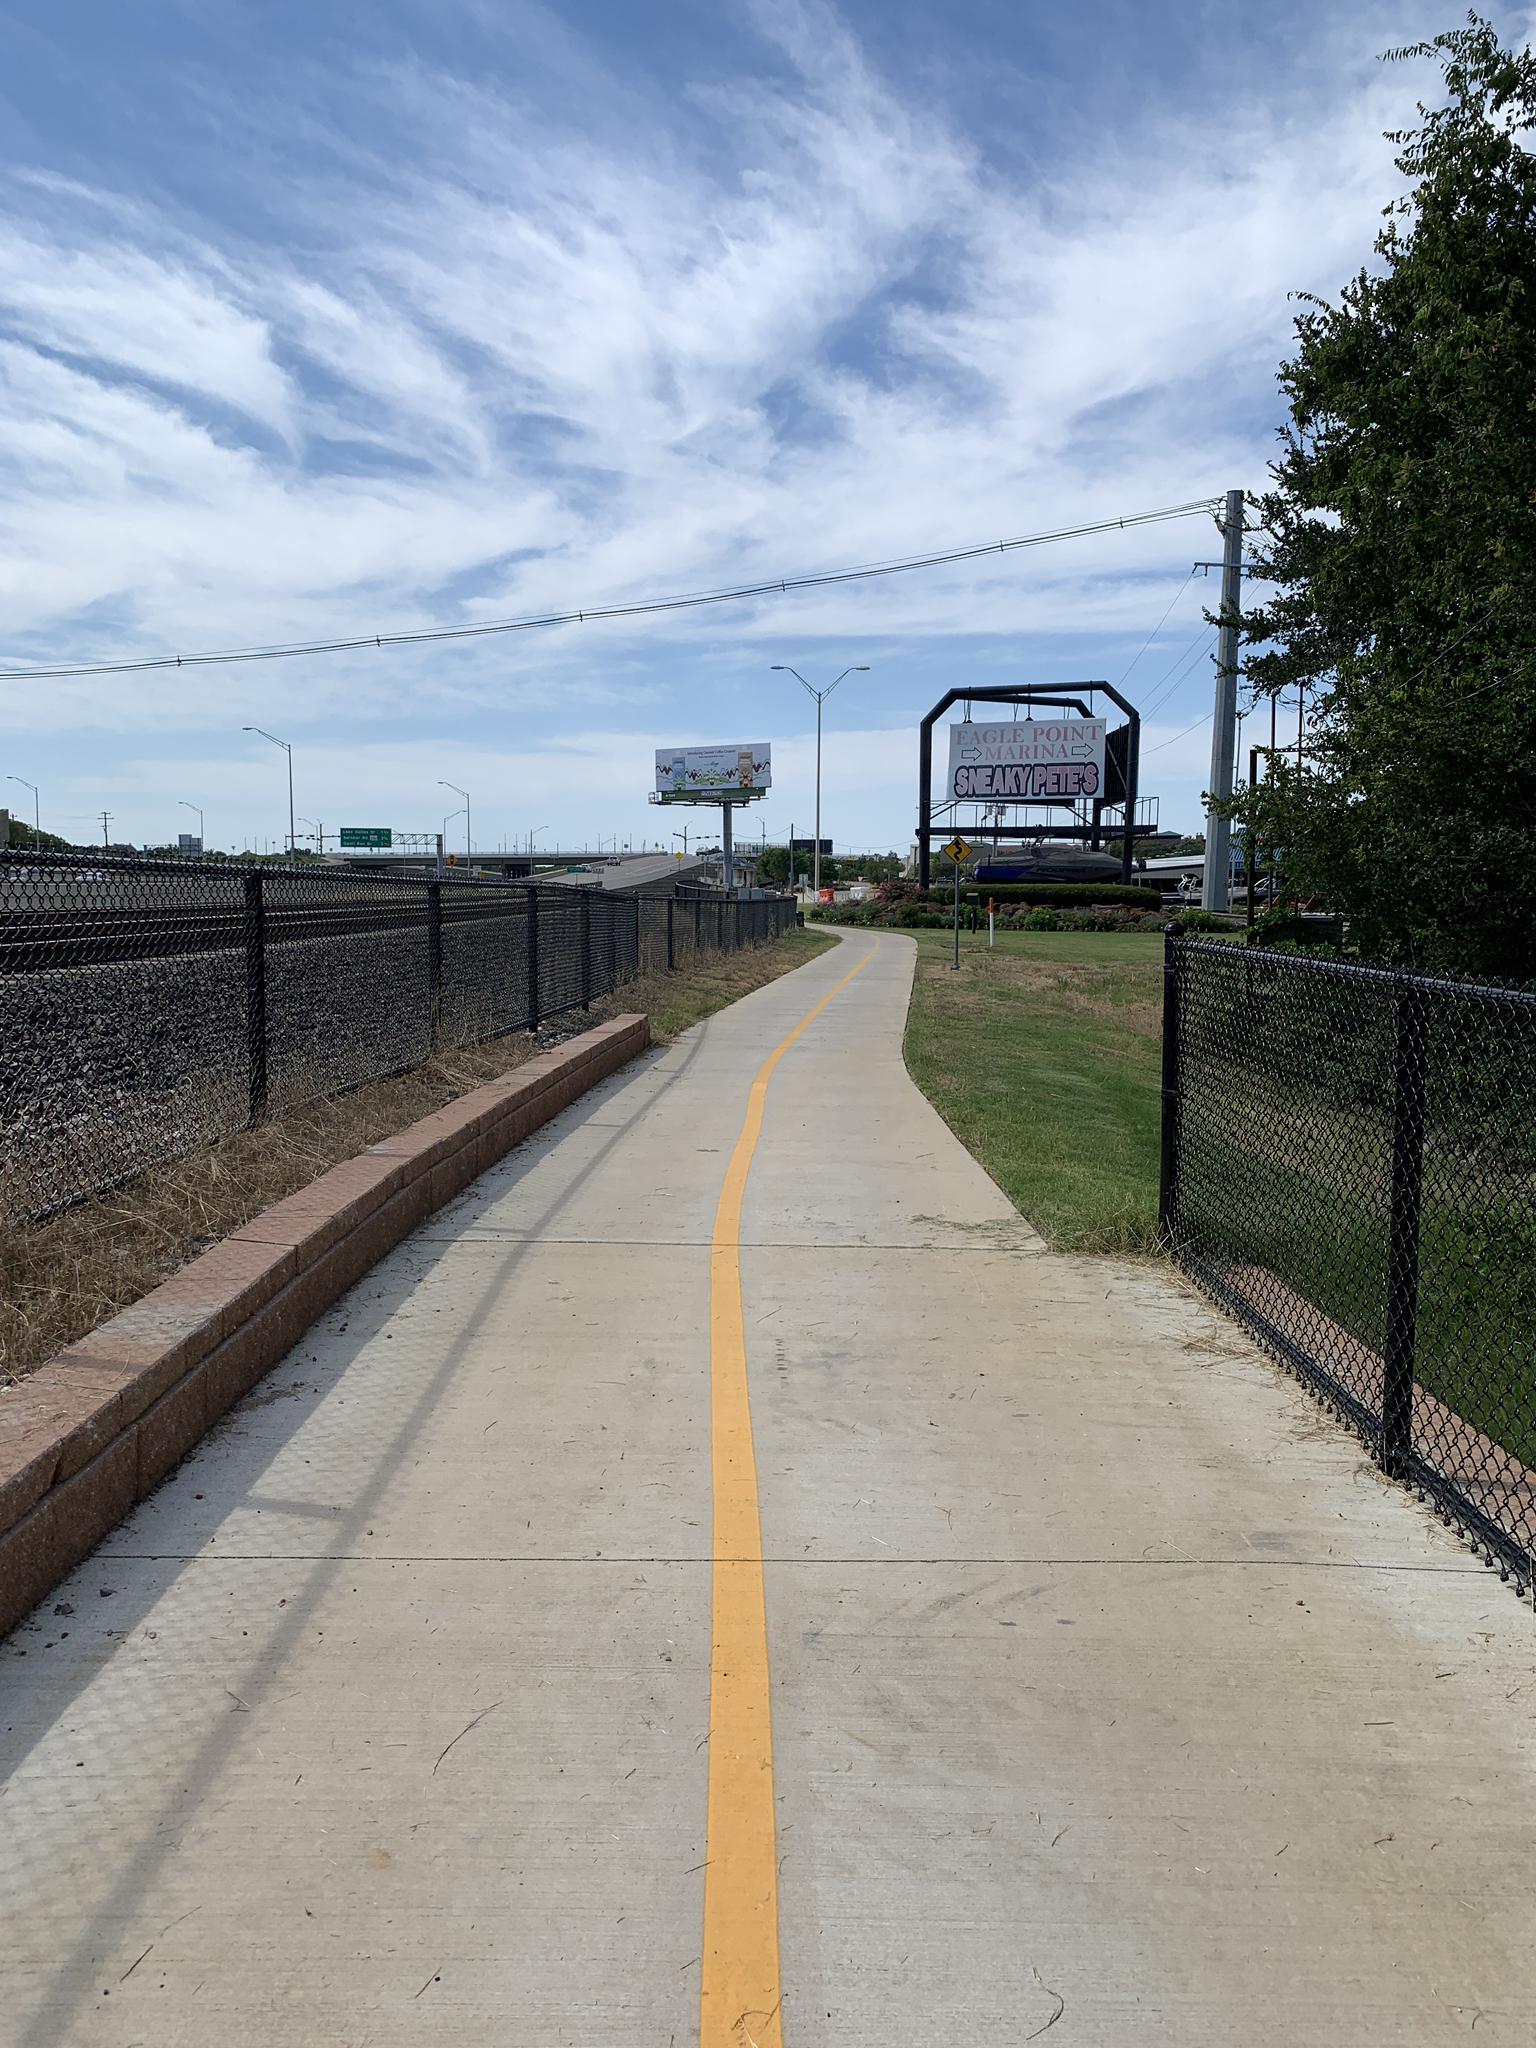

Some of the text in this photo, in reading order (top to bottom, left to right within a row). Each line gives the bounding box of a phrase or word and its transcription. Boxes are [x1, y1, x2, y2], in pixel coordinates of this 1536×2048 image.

[956, 725, 1102, 745] EAGLE POINT
[985, 743, 1068, 760] MARINA
[954, 762, 1099, 798] SNEAKY PETE'S
